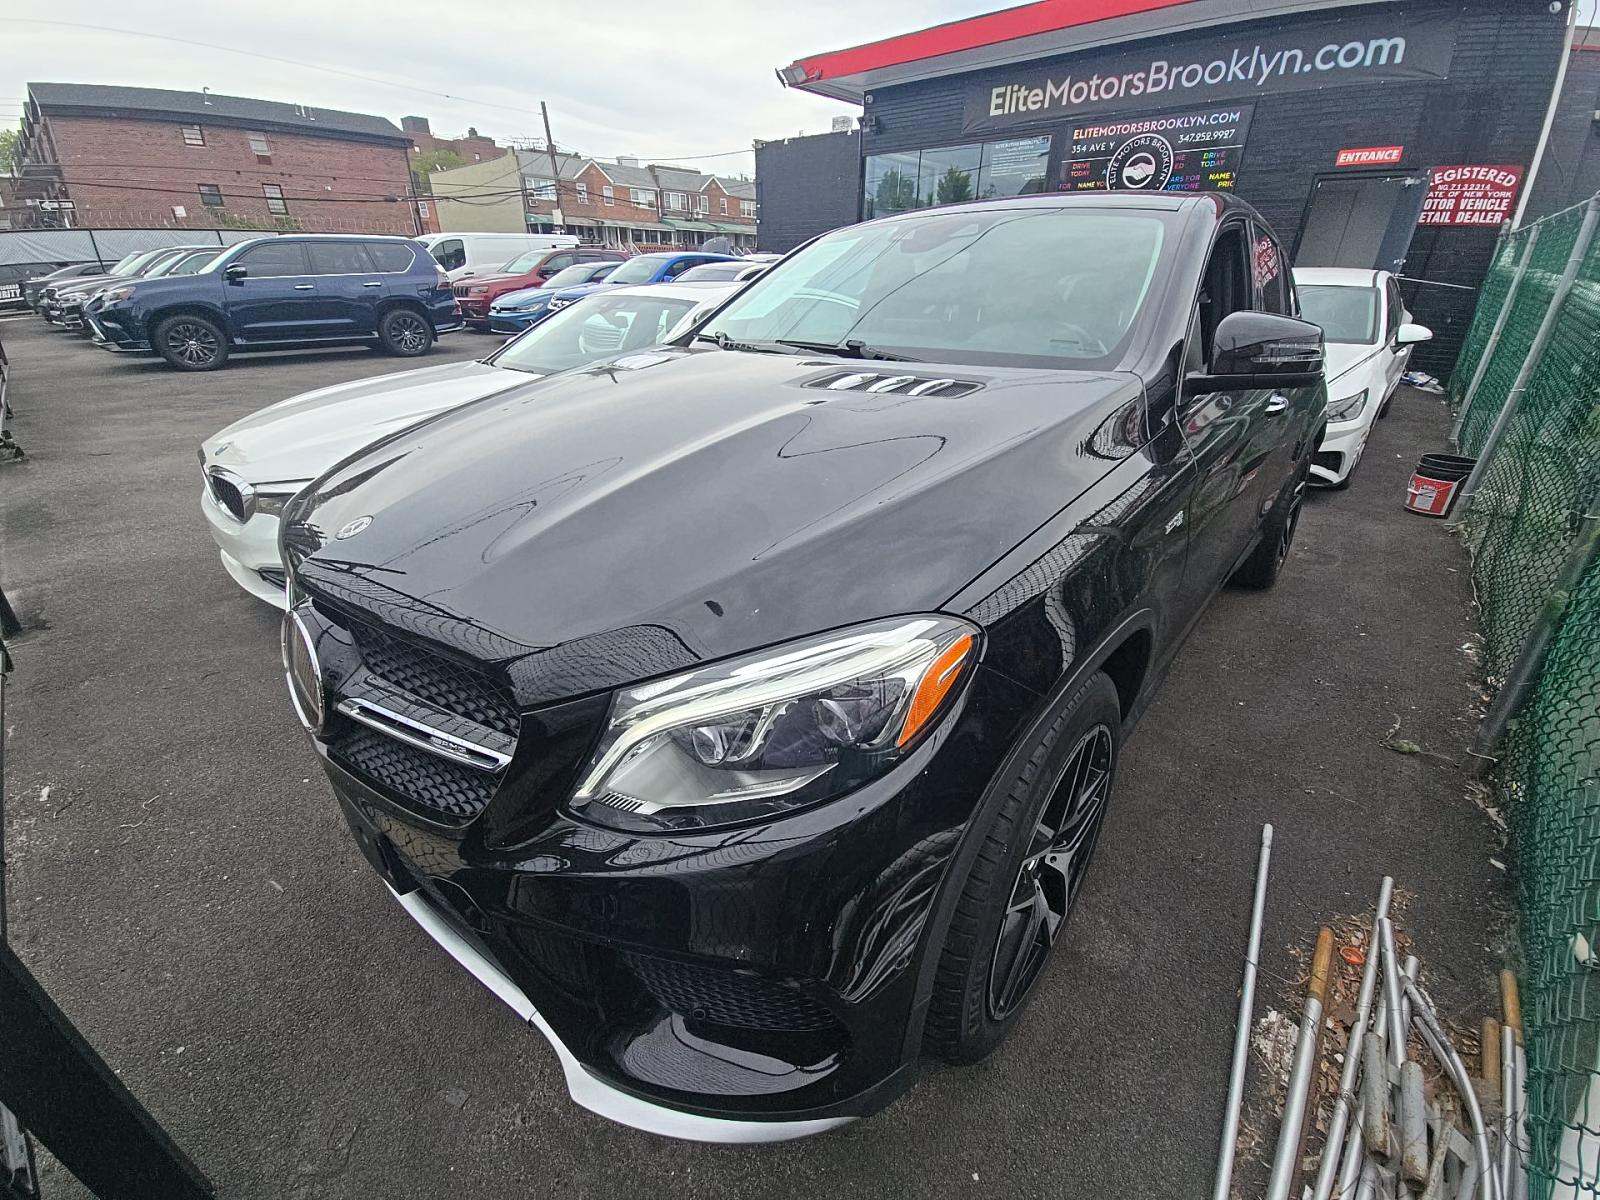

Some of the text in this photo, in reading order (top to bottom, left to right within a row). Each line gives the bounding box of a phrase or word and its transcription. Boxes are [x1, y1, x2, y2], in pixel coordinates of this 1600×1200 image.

[989, 36, 1406, 117] EliteMotorsBrooklyn.com
[1072, 111, 1241, 140] ELITEMOTORSBROOKLYN.COM
[1071, 141, 1115, 154] 354 AVE Y
[1109, 137, 1170, 184] ELITE MOTORS BROOKLYN
[1340, 149, 1400, 162] ENTRANCE
[1209, 172, 1231, 180] NAME
[1167, 182, 1200, 191] VERYONE
[1217, 180, 1235, 188] PRIC
[1423, 199, 1511, 211] OTOR VEHICLE
[1418, 211, 1503, 224] ETAIL DEALER
